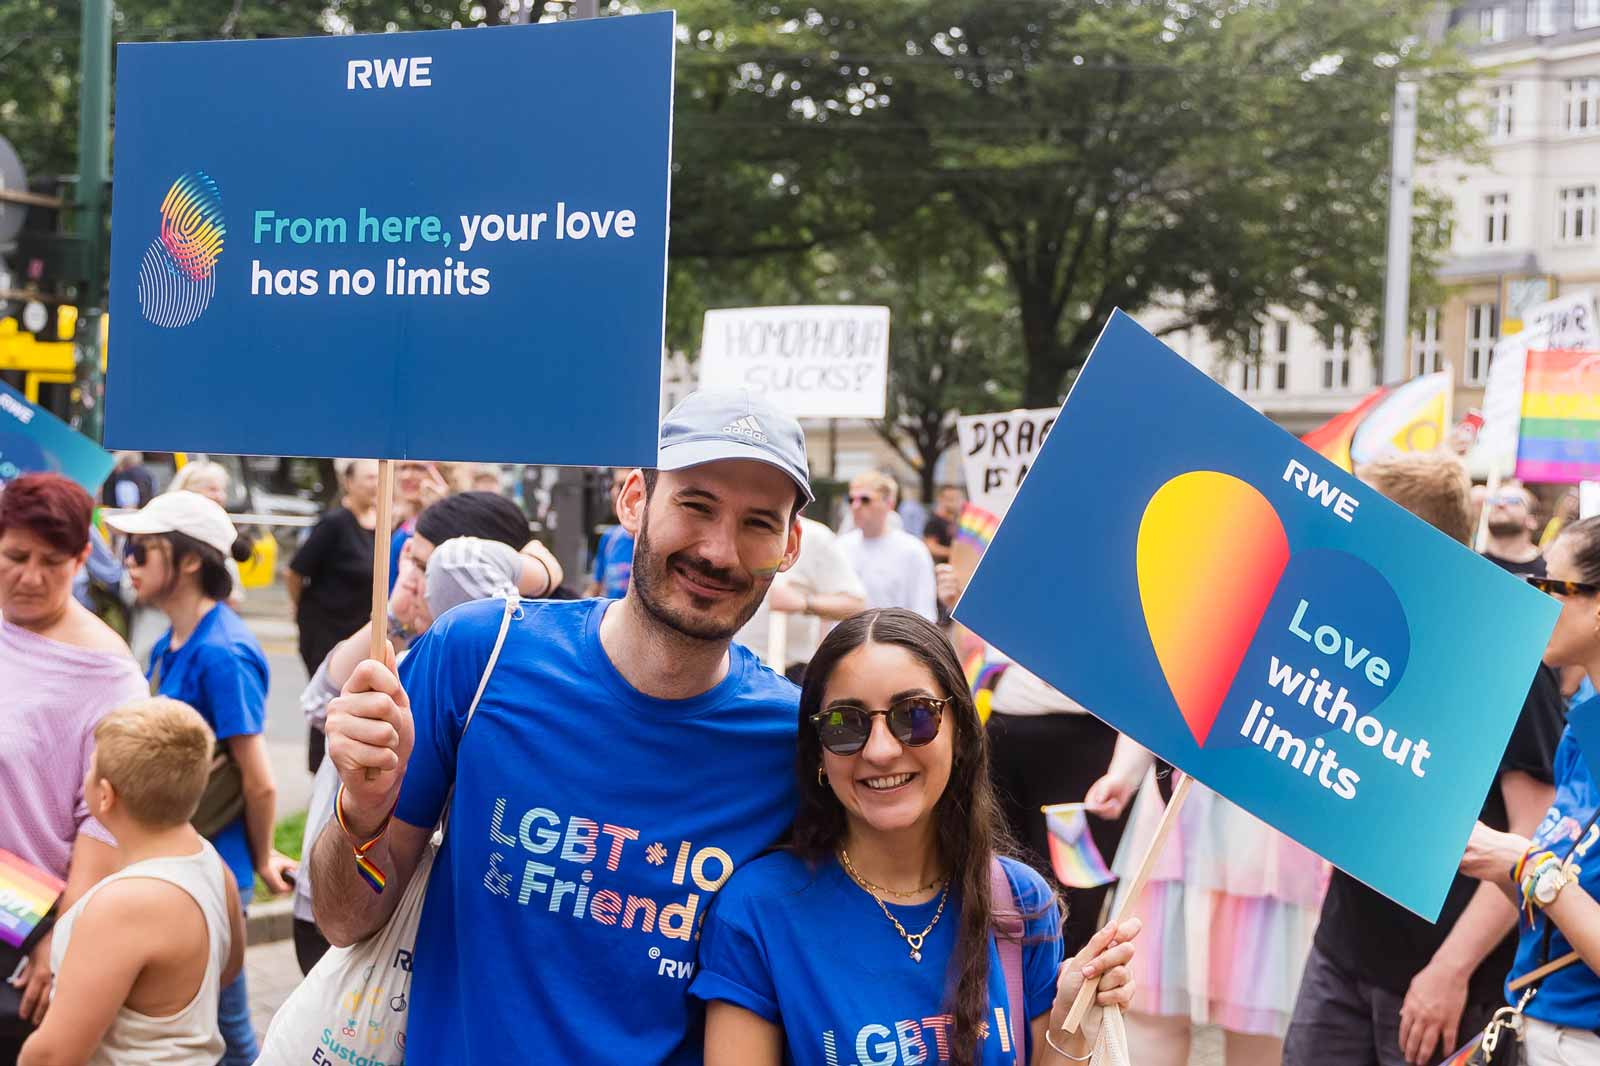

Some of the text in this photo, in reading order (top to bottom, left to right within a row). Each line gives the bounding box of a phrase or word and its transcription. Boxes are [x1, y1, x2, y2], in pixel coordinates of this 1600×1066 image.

[347, 56, 432, 90] RWE
[254, 202, 636, 252] From here, your love
[250, 257, 490, 295] has no limits
[721, 424, 768, 443] adidas
[1282, 458, 1360, 523] RWE
[1288, 599, 1391, 687] Love
[1239, 699, 1361, 800] limits
[1267, 656, 1432, 778] without
[483, 852, 706, 942] & Friend
